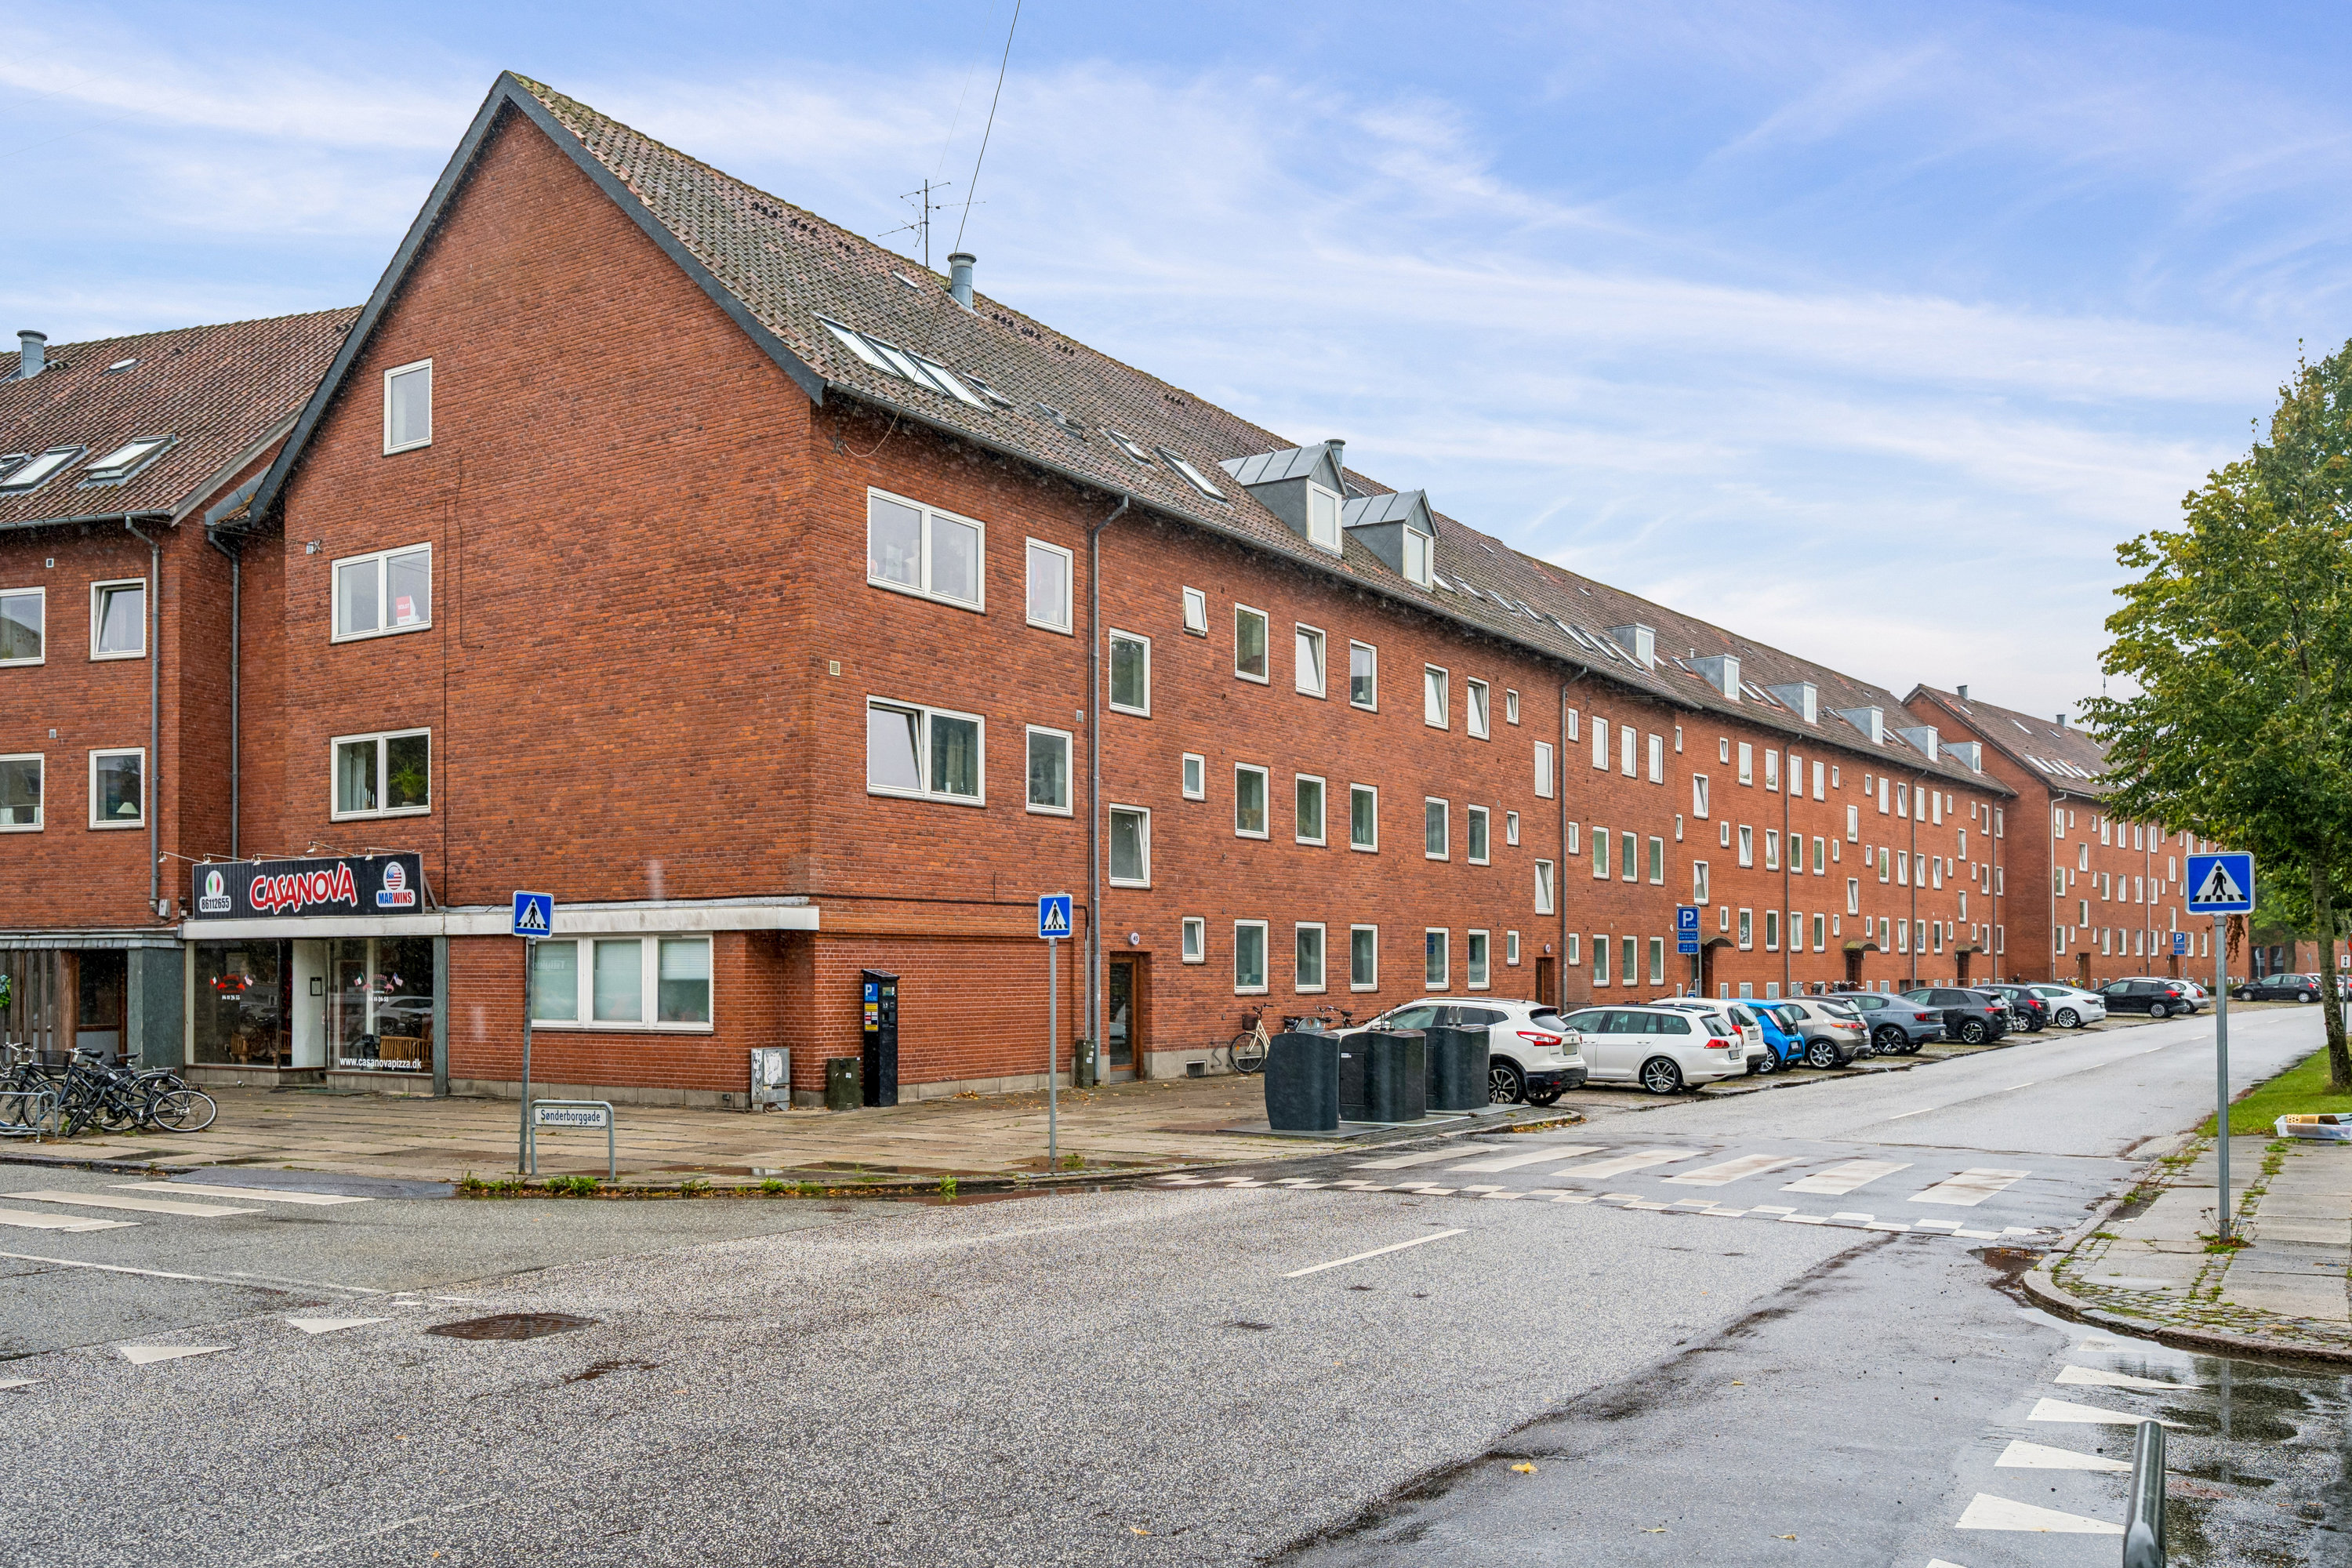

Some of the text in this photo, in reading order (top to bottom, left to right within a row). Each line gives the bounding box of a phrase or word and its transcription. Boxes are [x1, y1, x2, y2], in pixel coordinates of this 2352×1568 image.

[250, 862, 357, 914] CASANOVA
[201, 898, 229, 909] 86112655
[378, 891, 412, 904] MARWINS
[1682, 910, 1694, 927] P
[2176, 934, 2183, 942] P
[865, 984, 873, 996] P
[339, 1058, 422, 1070] www.casanovapizza.dk
[541, 1109, 601, 1124] Sønderborggade
